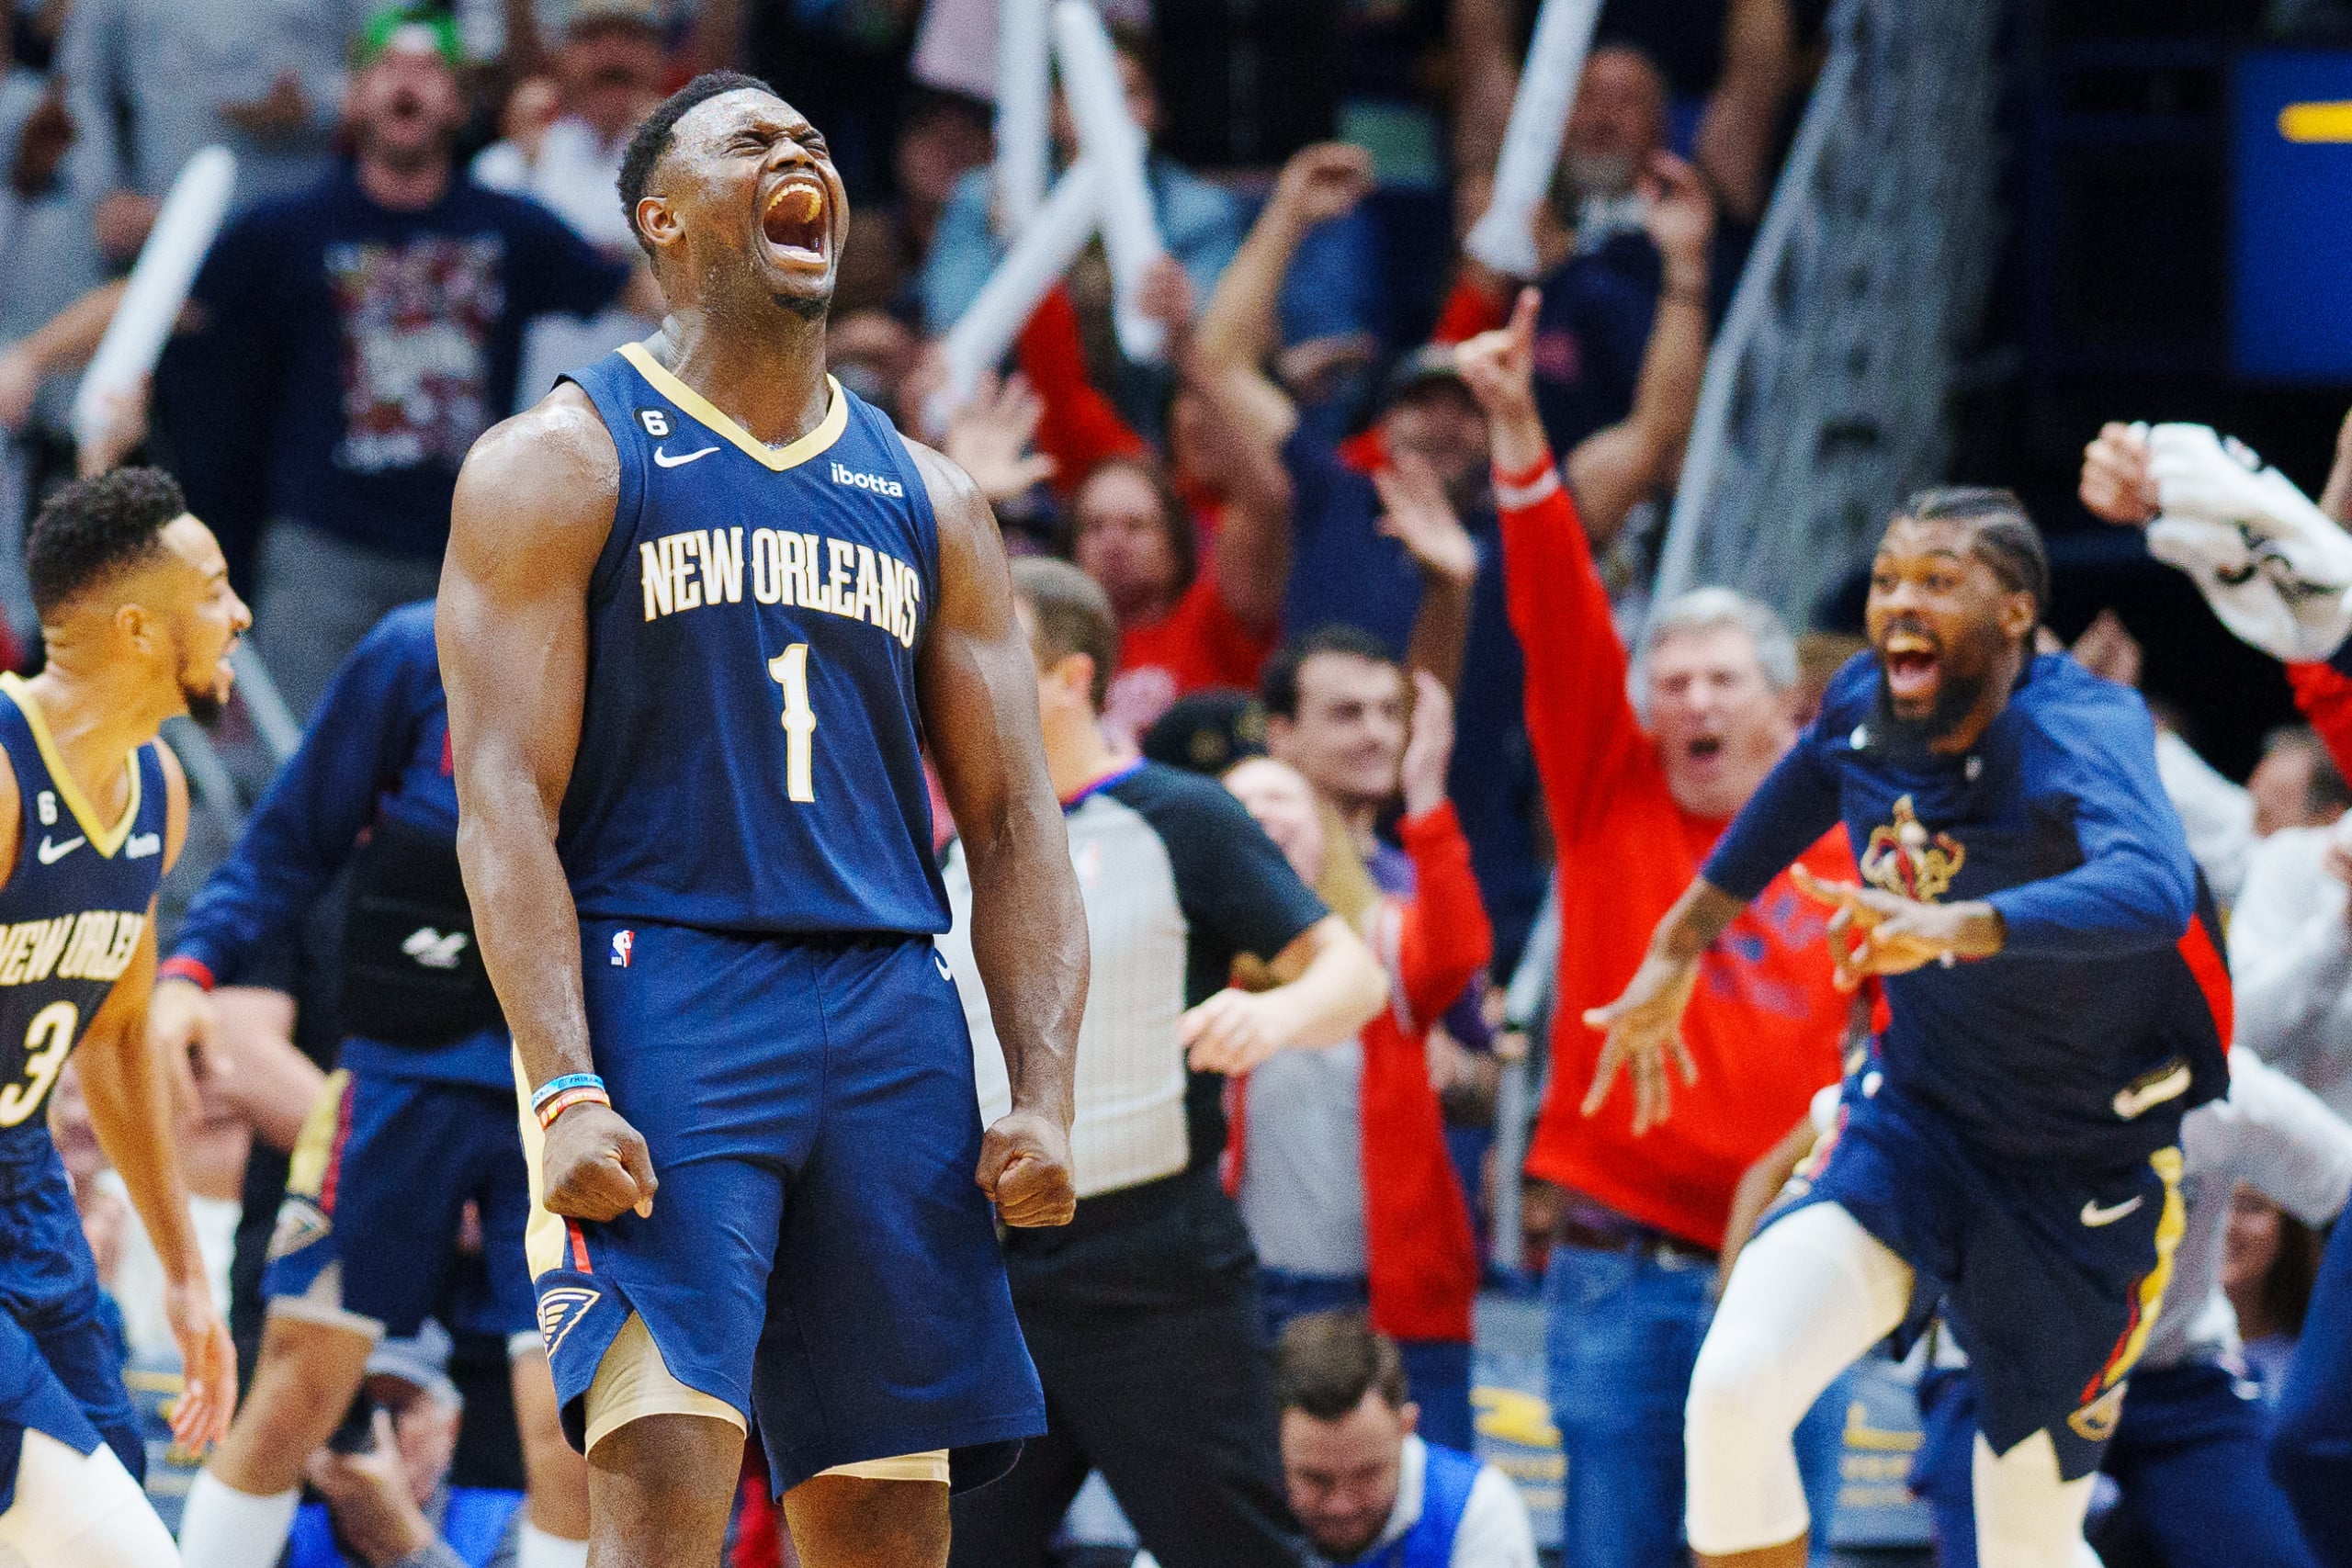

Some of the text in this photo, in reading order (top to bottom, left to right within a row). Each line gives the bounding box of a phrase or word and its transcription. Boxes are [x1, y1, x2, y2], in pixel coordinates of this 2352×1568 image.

[641, 410, 669, 436] 6
[831, 461, 903, 498] ibotta
[639, 526, 920, 649] NEW ORLEANS
[768, 643, 817, 803] 1
[37, 790, 58, 826] 6
[0, 1000, 79, 1128] 3
